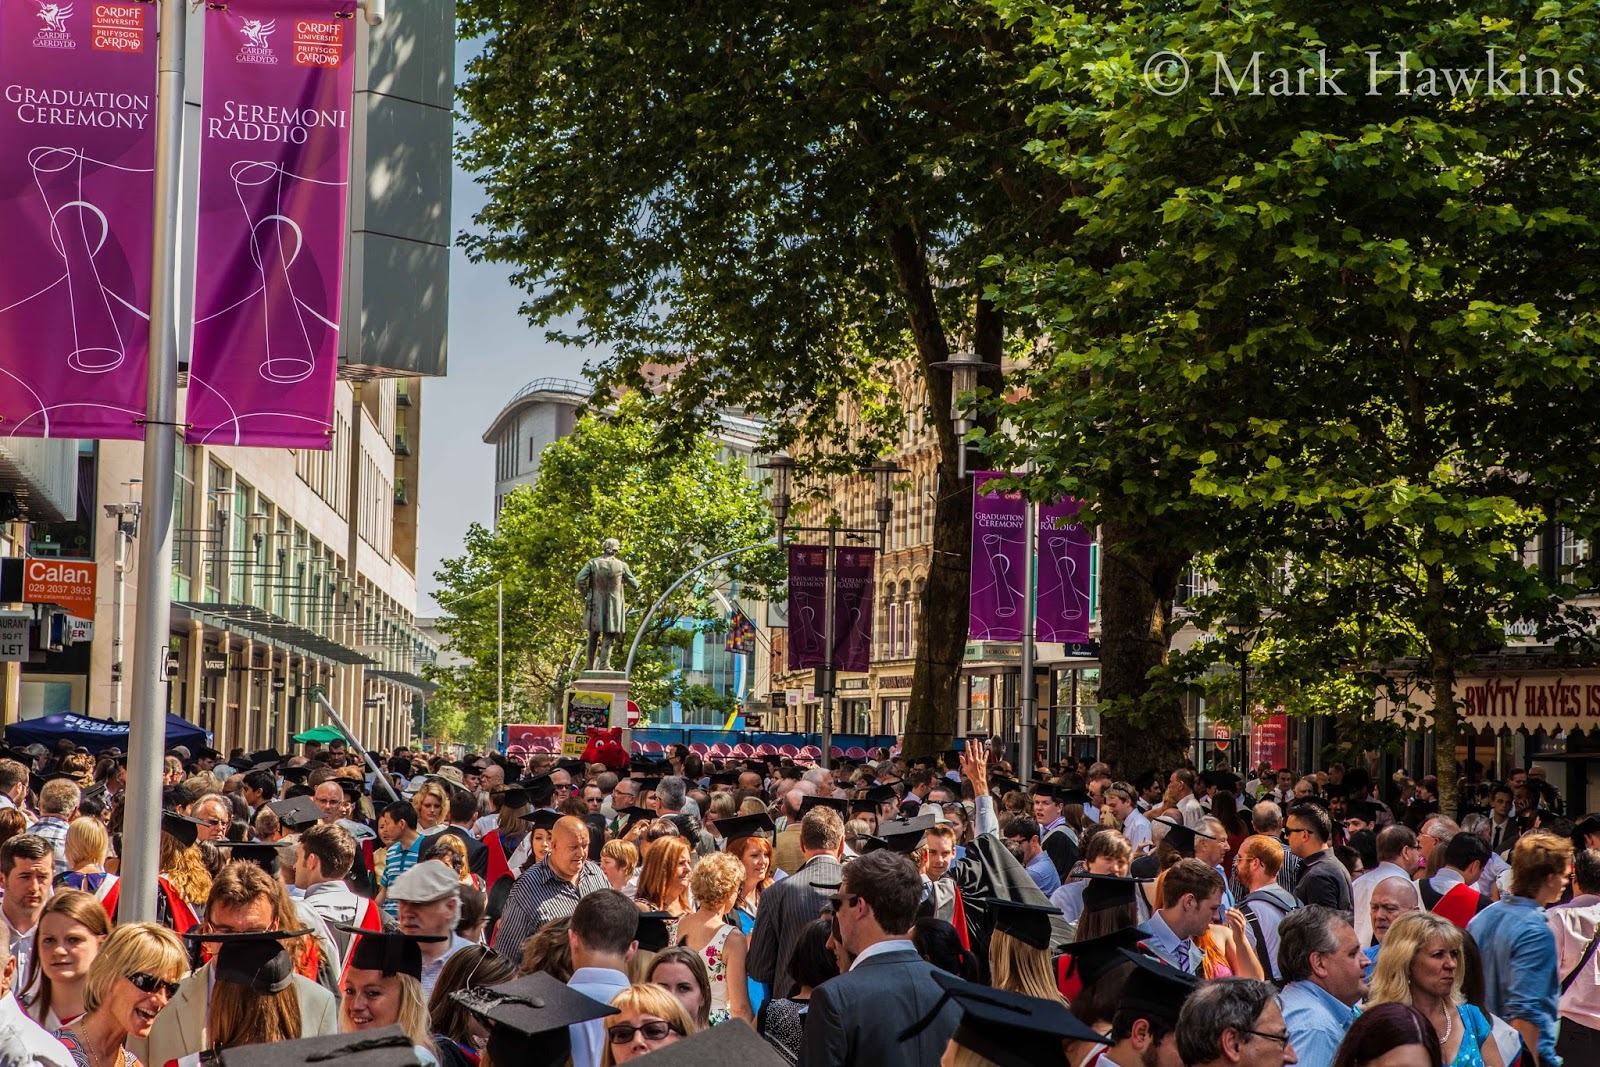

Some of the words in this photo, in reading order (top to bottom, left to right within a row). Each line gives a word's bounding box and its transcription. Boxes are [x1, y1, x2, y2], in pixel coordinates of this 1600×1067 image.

[96, 5, 141, 19] CARDIFF
[97, 17, 140, 26] UNIVERSITY
[297, 21, 341, 35] CARDIFF
[38, 31, 71, 39] CARDIFF
[97, 30, 139, 38] PRIFYSGOL
[298, 33, 339, 42] UNIVERSITY
[33, 39, 76, 48] CAERDYDD
[241, 47, 273, 55] CARDIFF
[298, 46, 338, 54] PRIFYSGOL
[236, 54, 278, 64] CAERDYDD
[5, 84, 149, 110] GRADUATION
[17, 103, 149, 130] CEREMONY
[223, 100, 346, 128] SEREMONI
[208, 117, 307, 145] RADDIO
[975, 512, 1024, 521] GRADUATION
[978, 519, 1024, 528] CEREMONY
[29, 562, 92, 584] Calan.
[28, 583, 45, 592] 029
[46, 584, 68, 593] 2037
[70, 586, 91, 595] 3933
[74, 621, 93, 629] UNIT
[2, 644, 24, 655] LET
[204, 660, 225, 670] VANS
[1465, 678, 1520, 717] BWYTY
[1525, 677, 1581, 717] HAYES
